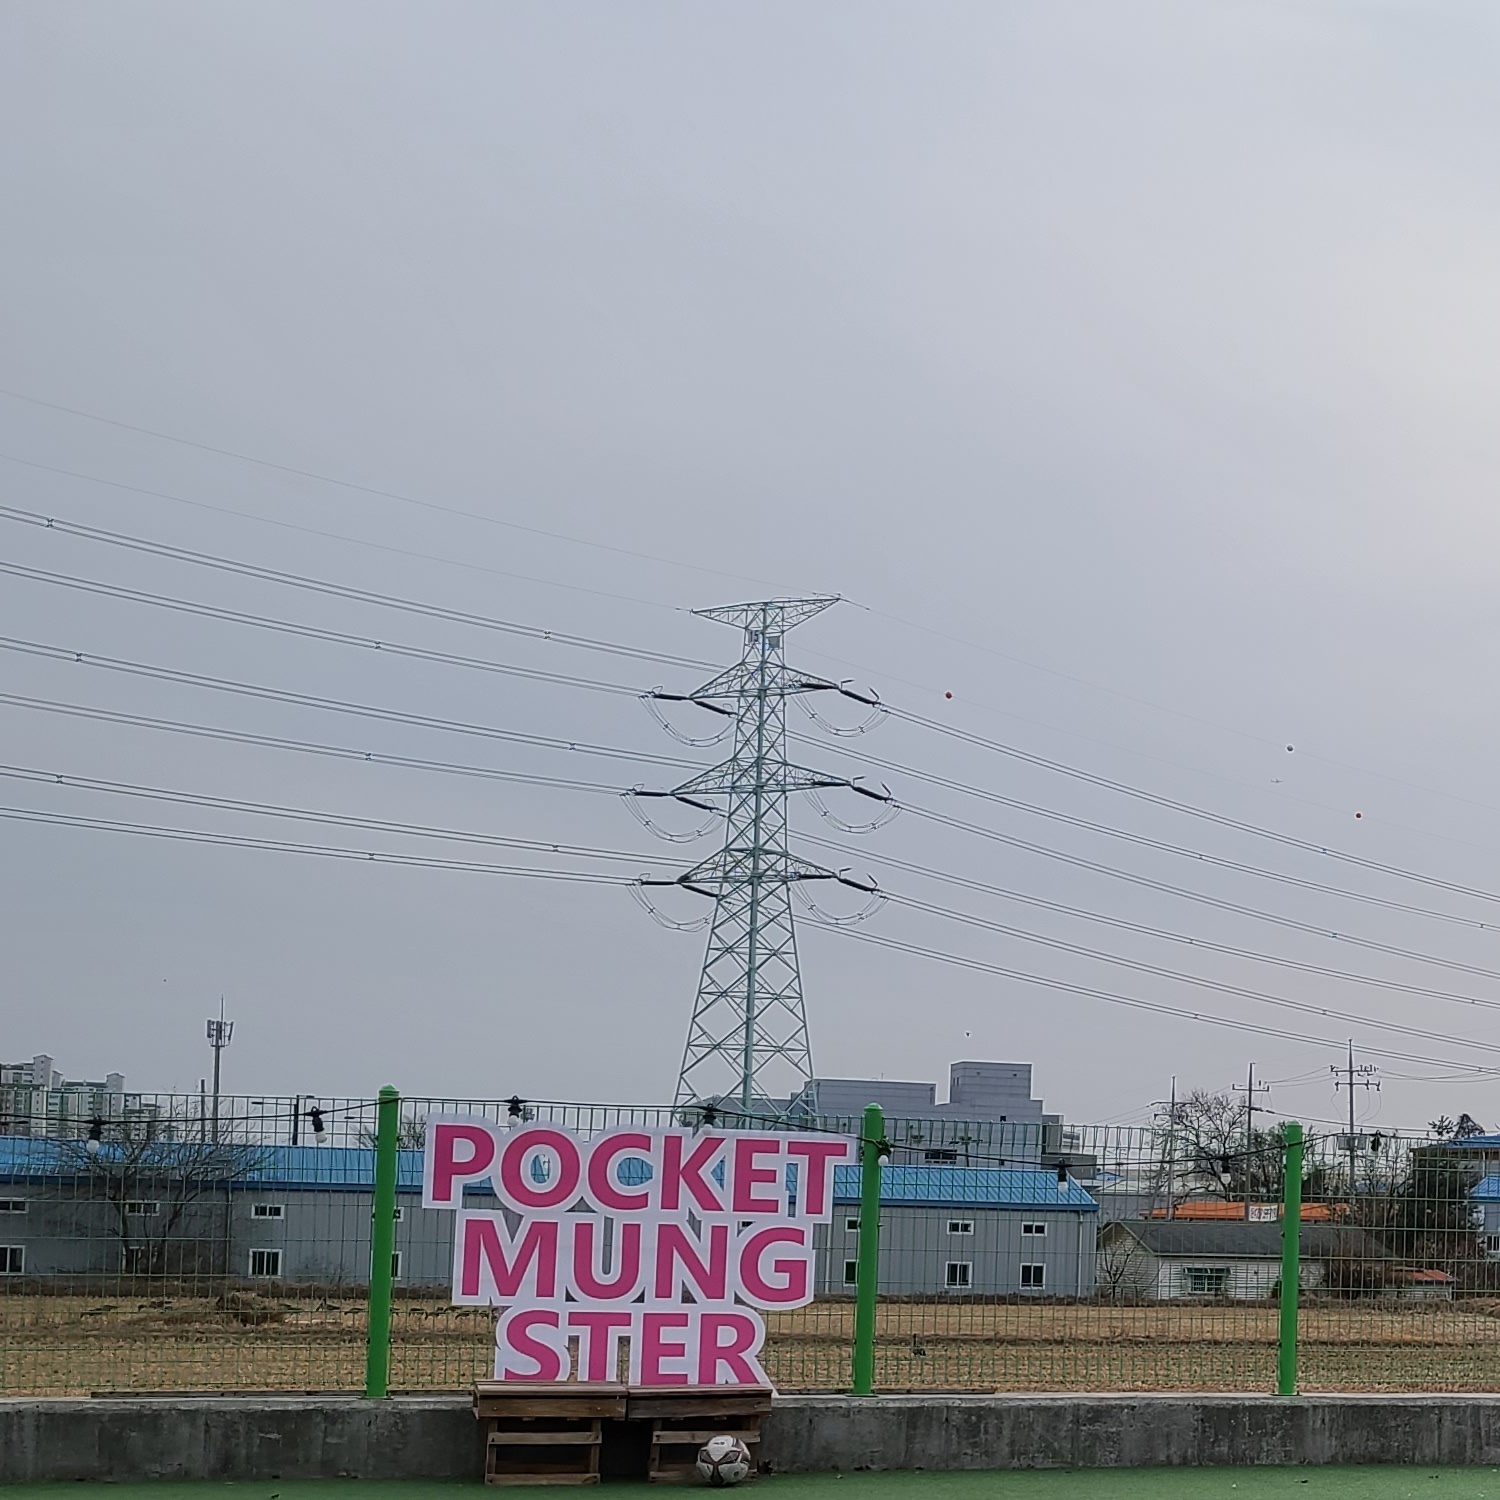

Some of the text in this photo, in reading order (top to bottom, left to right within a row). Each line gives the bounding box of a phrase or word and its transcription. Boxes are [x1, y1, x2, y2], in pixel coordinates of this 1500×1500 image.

[431, 1123, 848, 1216] POCKET
[461, 1218, 808, 1303] MUNG
[503, 1309, 760, 1385] STER
